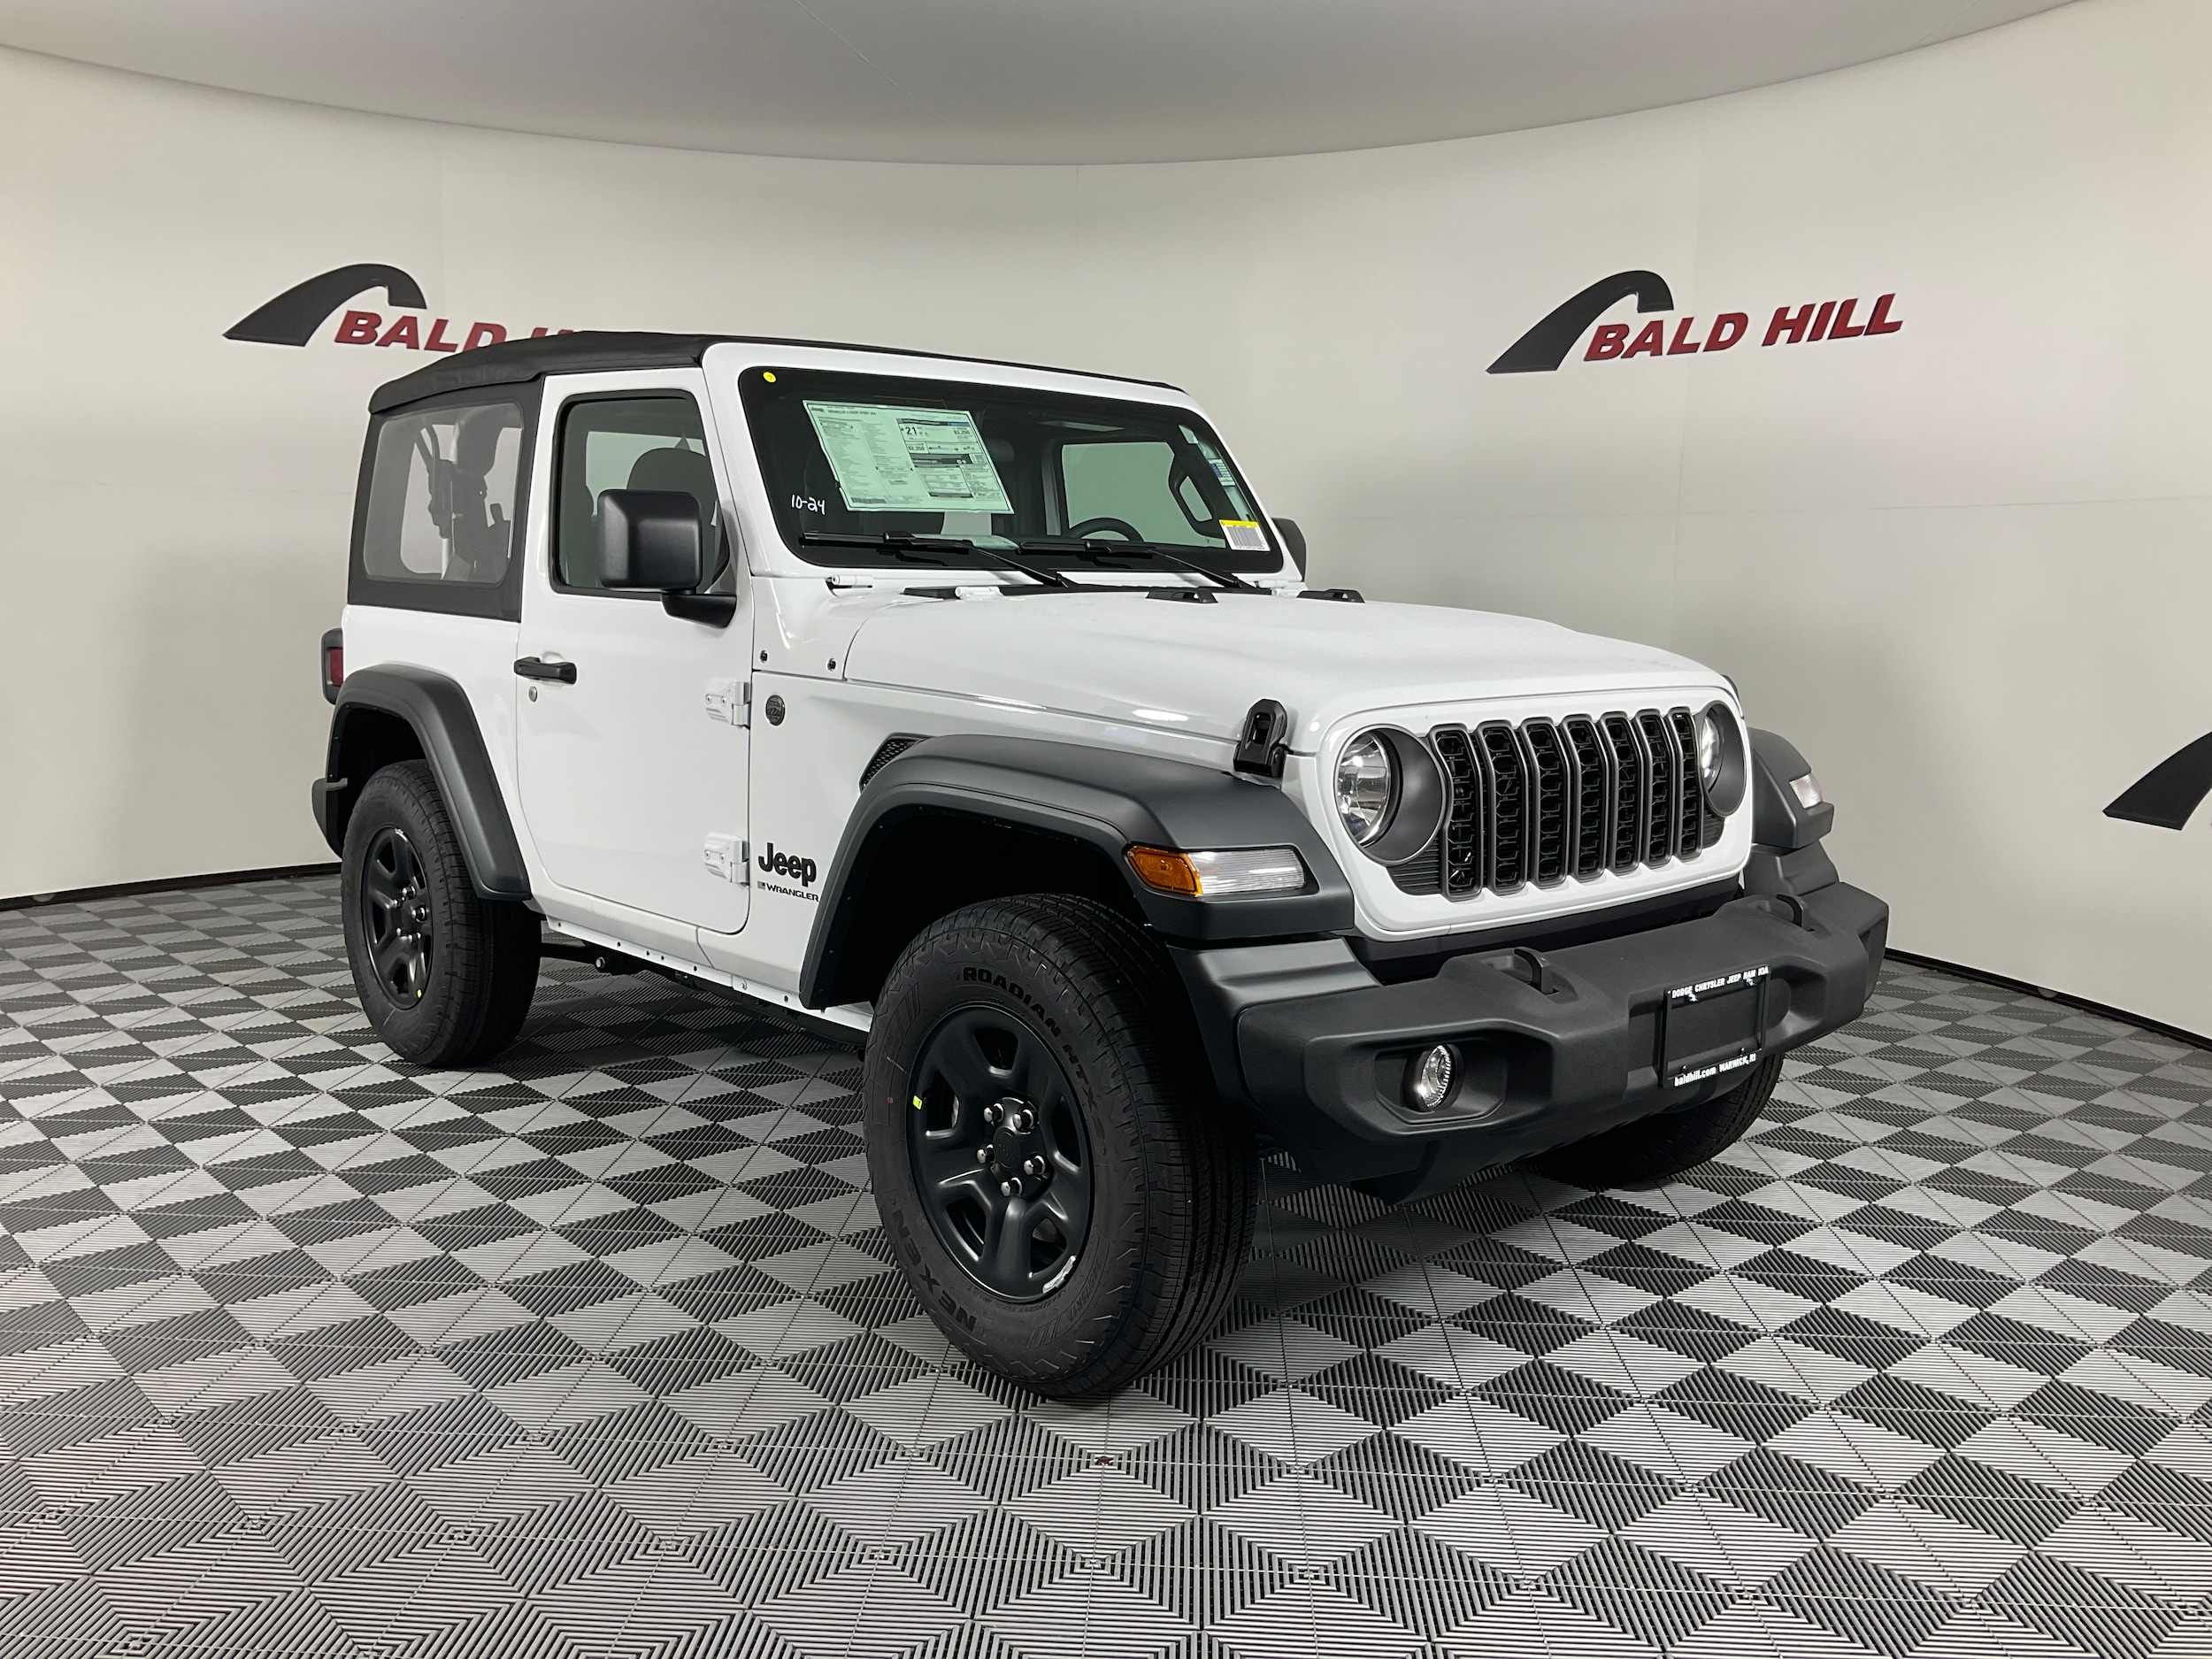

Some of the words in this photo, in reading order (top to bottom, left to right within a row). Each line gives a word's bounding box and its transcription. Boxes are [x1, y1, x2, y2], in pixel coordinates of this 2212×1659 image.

[334, 310, 507, 353] BALD
[1584, 312, 1749, 361] BALD
[1762, 293, 1904, 347] HILL
[905, 426, 917, 435] 21
[791, 494, 826, 515] 10-24
[757, 842, 817, 887] Jeep
[765, 883, 819, 902] WRANGLER
[963, 966, 1062, 1037] ROADIAN
[1671, 986, 1694, 999] DODGE
[1694, 978, 1725, 993] CHRYSLER
[1726, 972, 1741, 985] JEEP
[1743, 970, 1756, 979] RAM
[1758, 966, 1769, 976] KIA
[1674, 1066, 1717, 1087] baldhill.com
[1718, 1055, 1749, 1073] WARWICK,
[1749, 1053, 1756, 1063] RI
[891, 1209, 978, 1332] NEXEN
